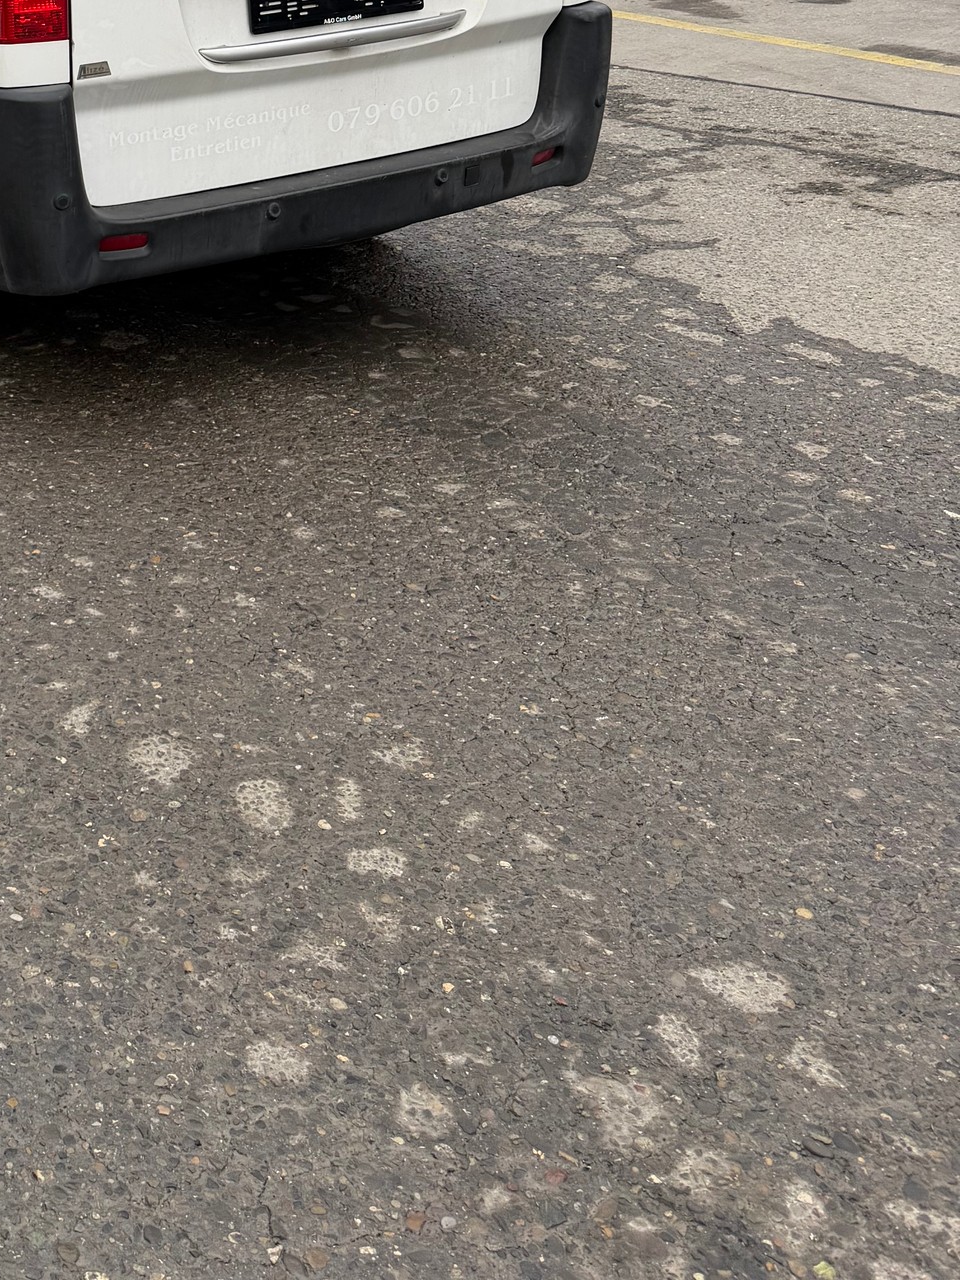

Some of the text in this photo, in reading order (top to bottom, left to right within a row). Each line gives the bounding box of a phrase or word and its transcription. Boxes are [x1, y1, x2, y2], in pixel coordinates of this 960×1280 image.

[323, 17, 335, 25] A&O
[347, 13, 362, 21] GmbH
[327, 76, 514, 133] 079 606 21 11
[108, 102, 311, 148] Montage Mécanique
[170, 133, 262, 162] Entretien
